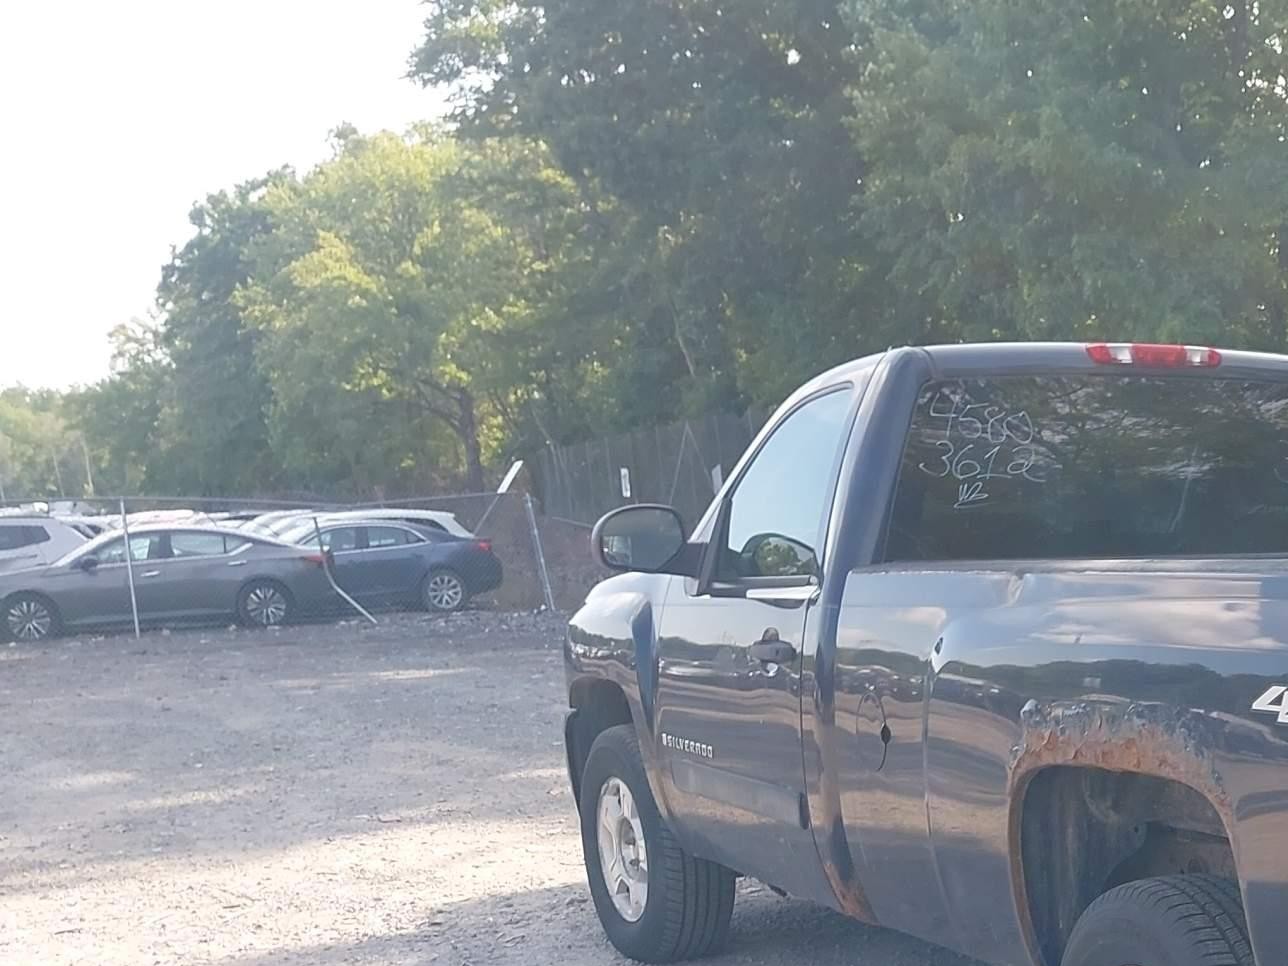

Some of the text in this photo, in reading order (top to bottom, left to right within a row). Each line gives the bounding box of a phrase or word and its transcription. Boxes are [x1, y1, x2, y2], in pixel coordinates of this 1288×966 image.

[930, 392, 1033, 444] 4580
[919, 440, 1046, 482] 3612
[667, 735, 713, 758] SILVERADO
